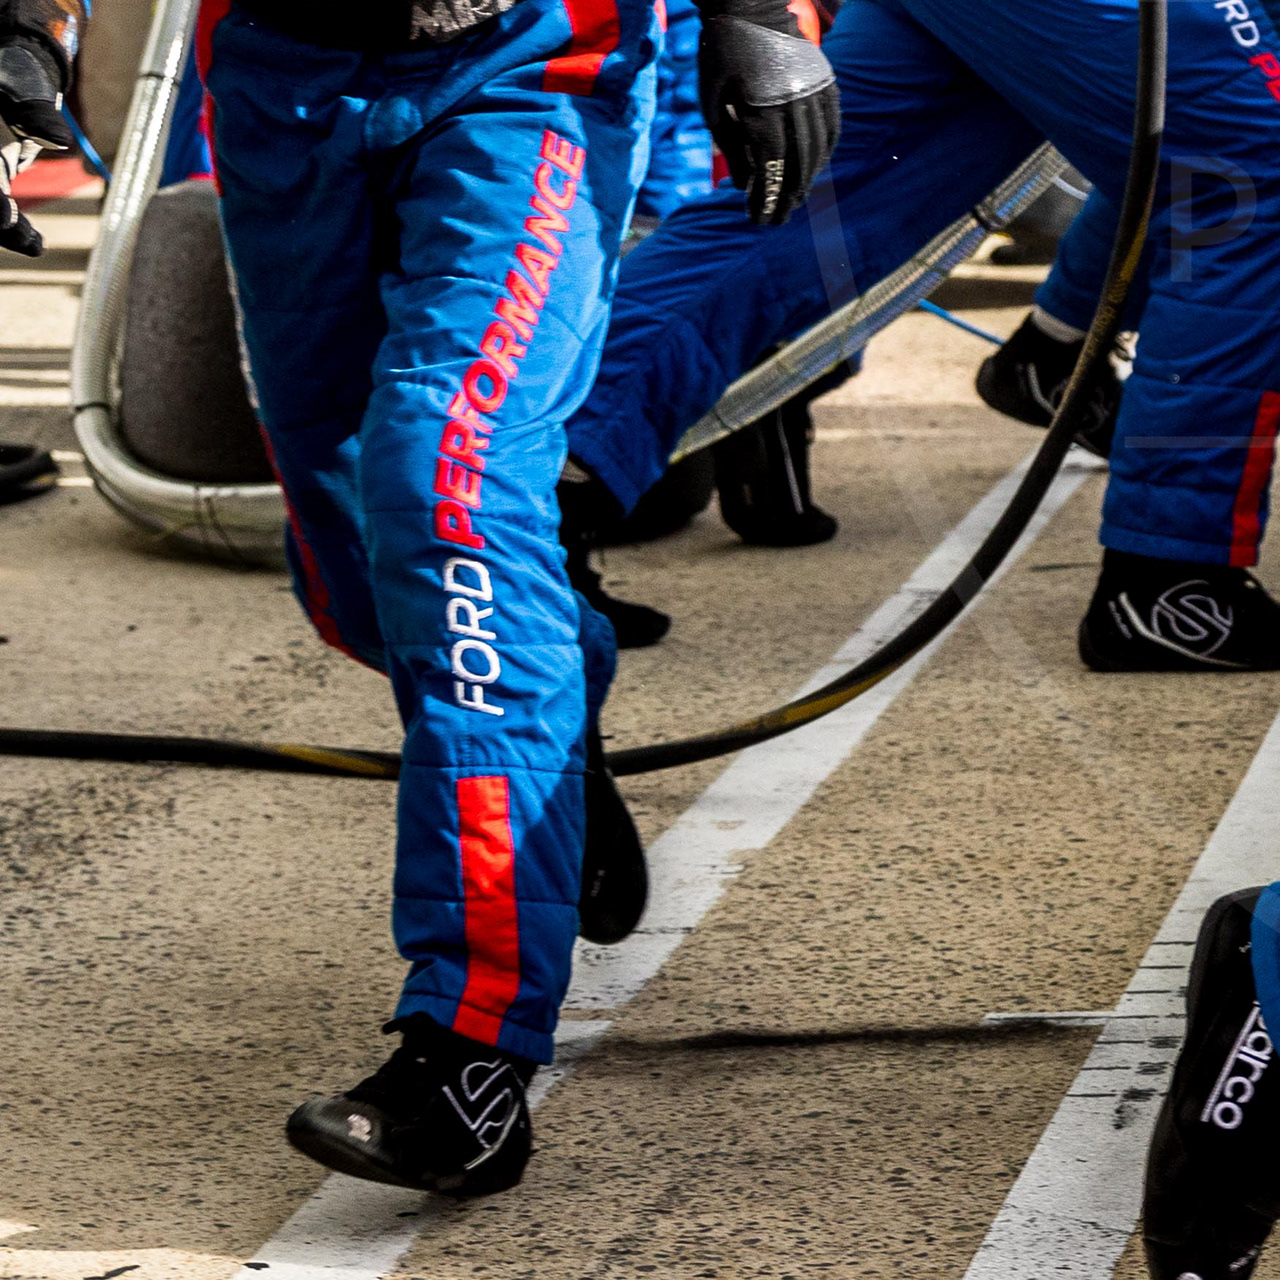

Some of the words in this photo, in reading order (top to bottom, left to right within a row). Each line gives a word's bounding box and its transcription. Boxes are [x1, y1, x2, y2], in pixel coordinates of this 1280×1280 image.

[434, 129, 587, 550] PERFORMANCE
[444, 557, 505, 717] FORD
[1200, 1001, 1274, 1130] arco
